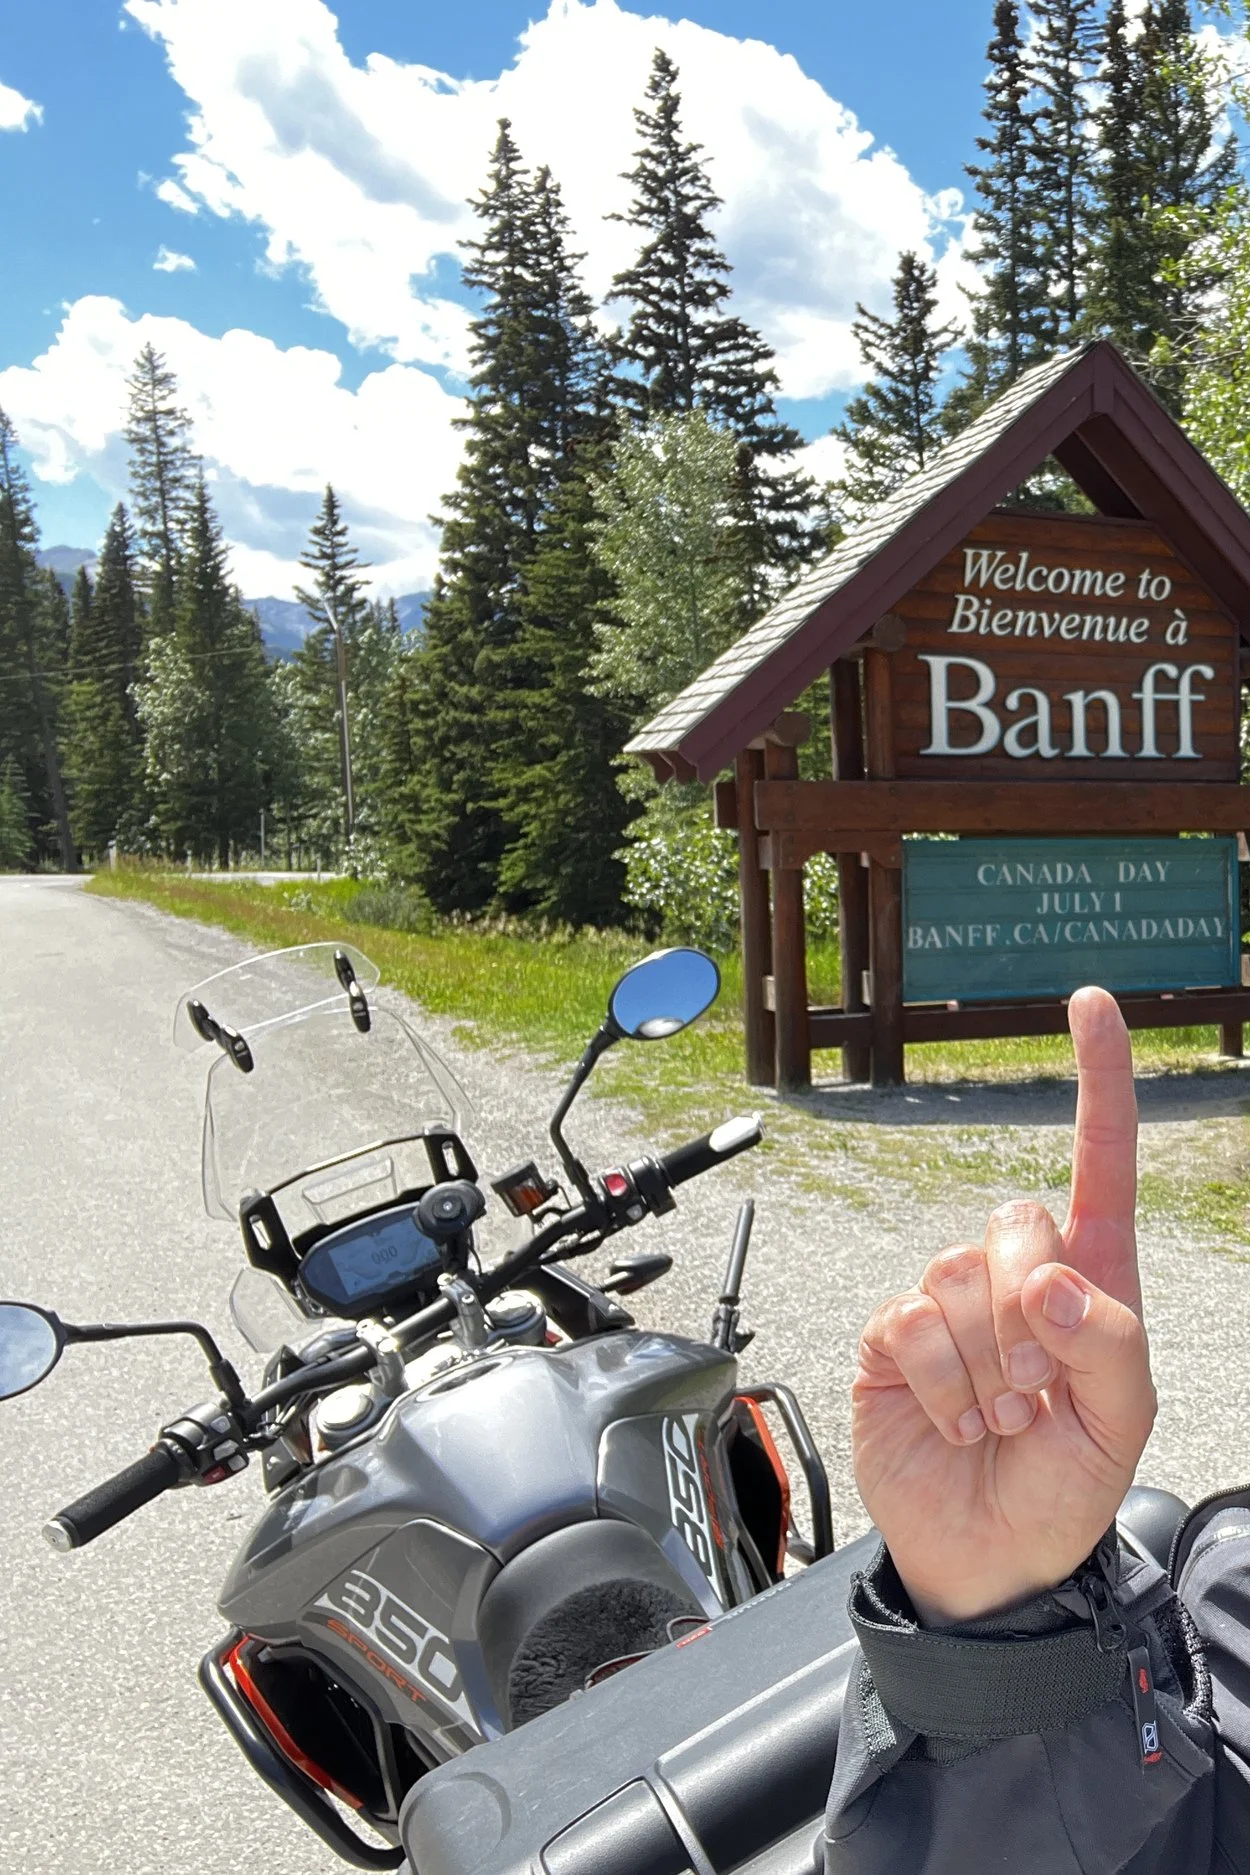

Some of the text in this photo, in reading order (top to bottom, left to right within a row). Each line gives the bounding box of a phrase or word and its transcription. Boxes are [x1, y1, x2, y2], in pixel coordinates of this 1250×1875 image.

[962, 548, 1172, 601] Welcome to
[947, 594, 1188, 646] Bienvenue à
[917, 654, 1215, 759] Banff
[976, 861, 1171, 886] CANADA DAY
[1037, 892, 1105, 915] JULY
[326, 1618, 428, 1704] SPORT
